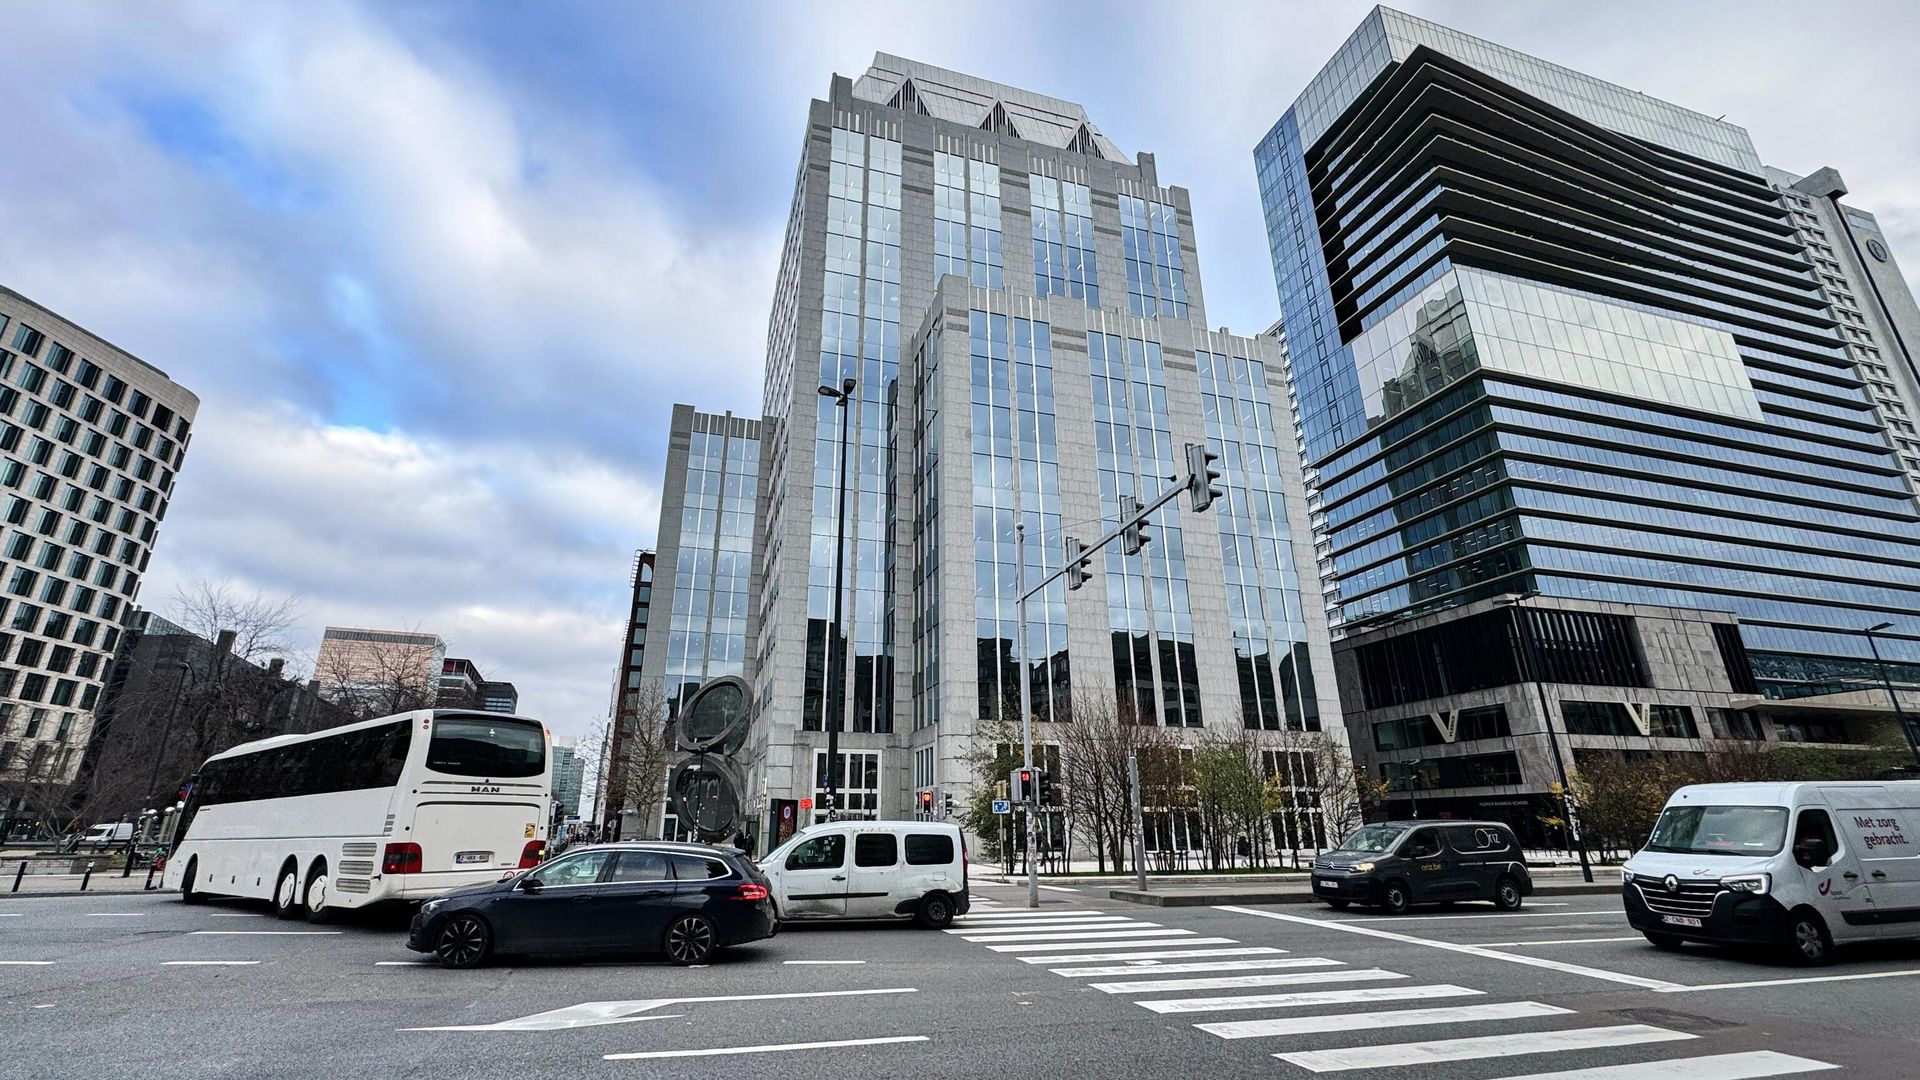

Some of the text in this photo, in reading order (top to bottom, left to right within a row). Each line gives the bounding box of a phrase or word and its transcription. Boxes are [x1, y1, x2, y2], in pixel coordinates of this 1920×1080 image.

[1853, 815, 1900, 831] Met zorg
[1864, 831, 1909, 849] gebracht.
